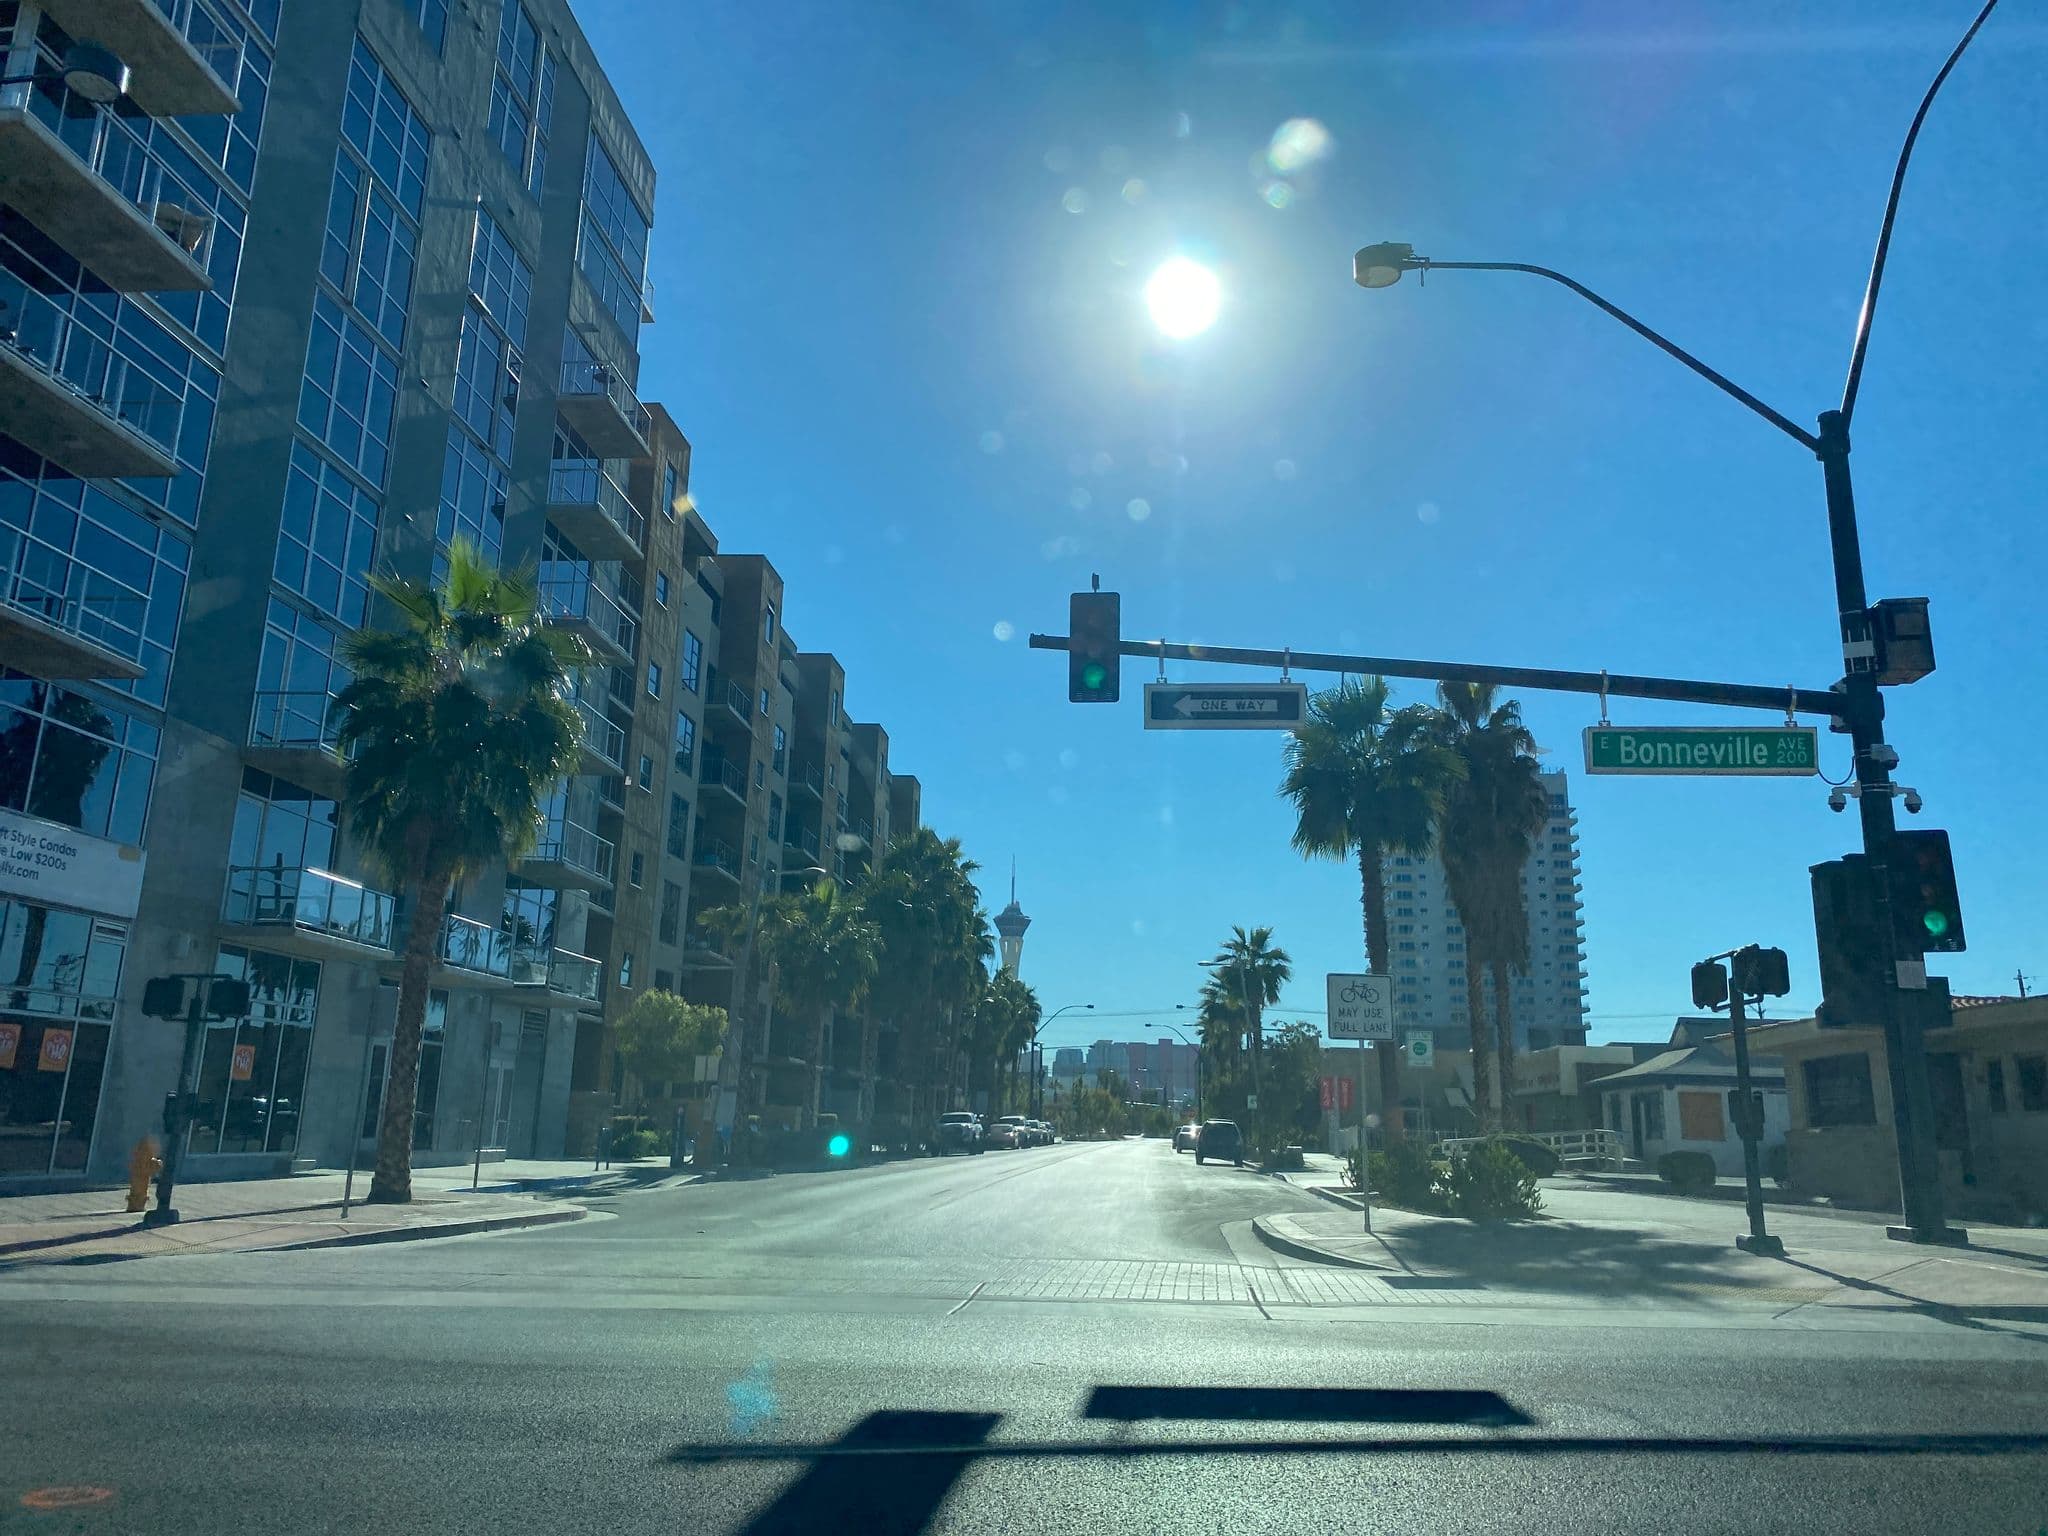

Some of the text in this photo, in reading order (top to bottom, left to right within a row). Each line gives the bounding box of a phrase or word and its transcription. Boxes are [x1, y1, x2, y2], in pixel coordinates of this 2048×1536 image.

[1201, 700, 1264, 711] ONE WAY
[1600, 735, 1806, 765] E Bonneville AVE
[1777, 750, 1808, 764] 200
[11, 830, 37, 847] Style
[39, 838, 77, 857] Condos
[10, 846, 33, 861] Low
[35, 853, 67, 871] $200s
[1338, 1007, 1384, 1018] MAY USE
[1334, 1021, 1388, 1033] FULL LANE
